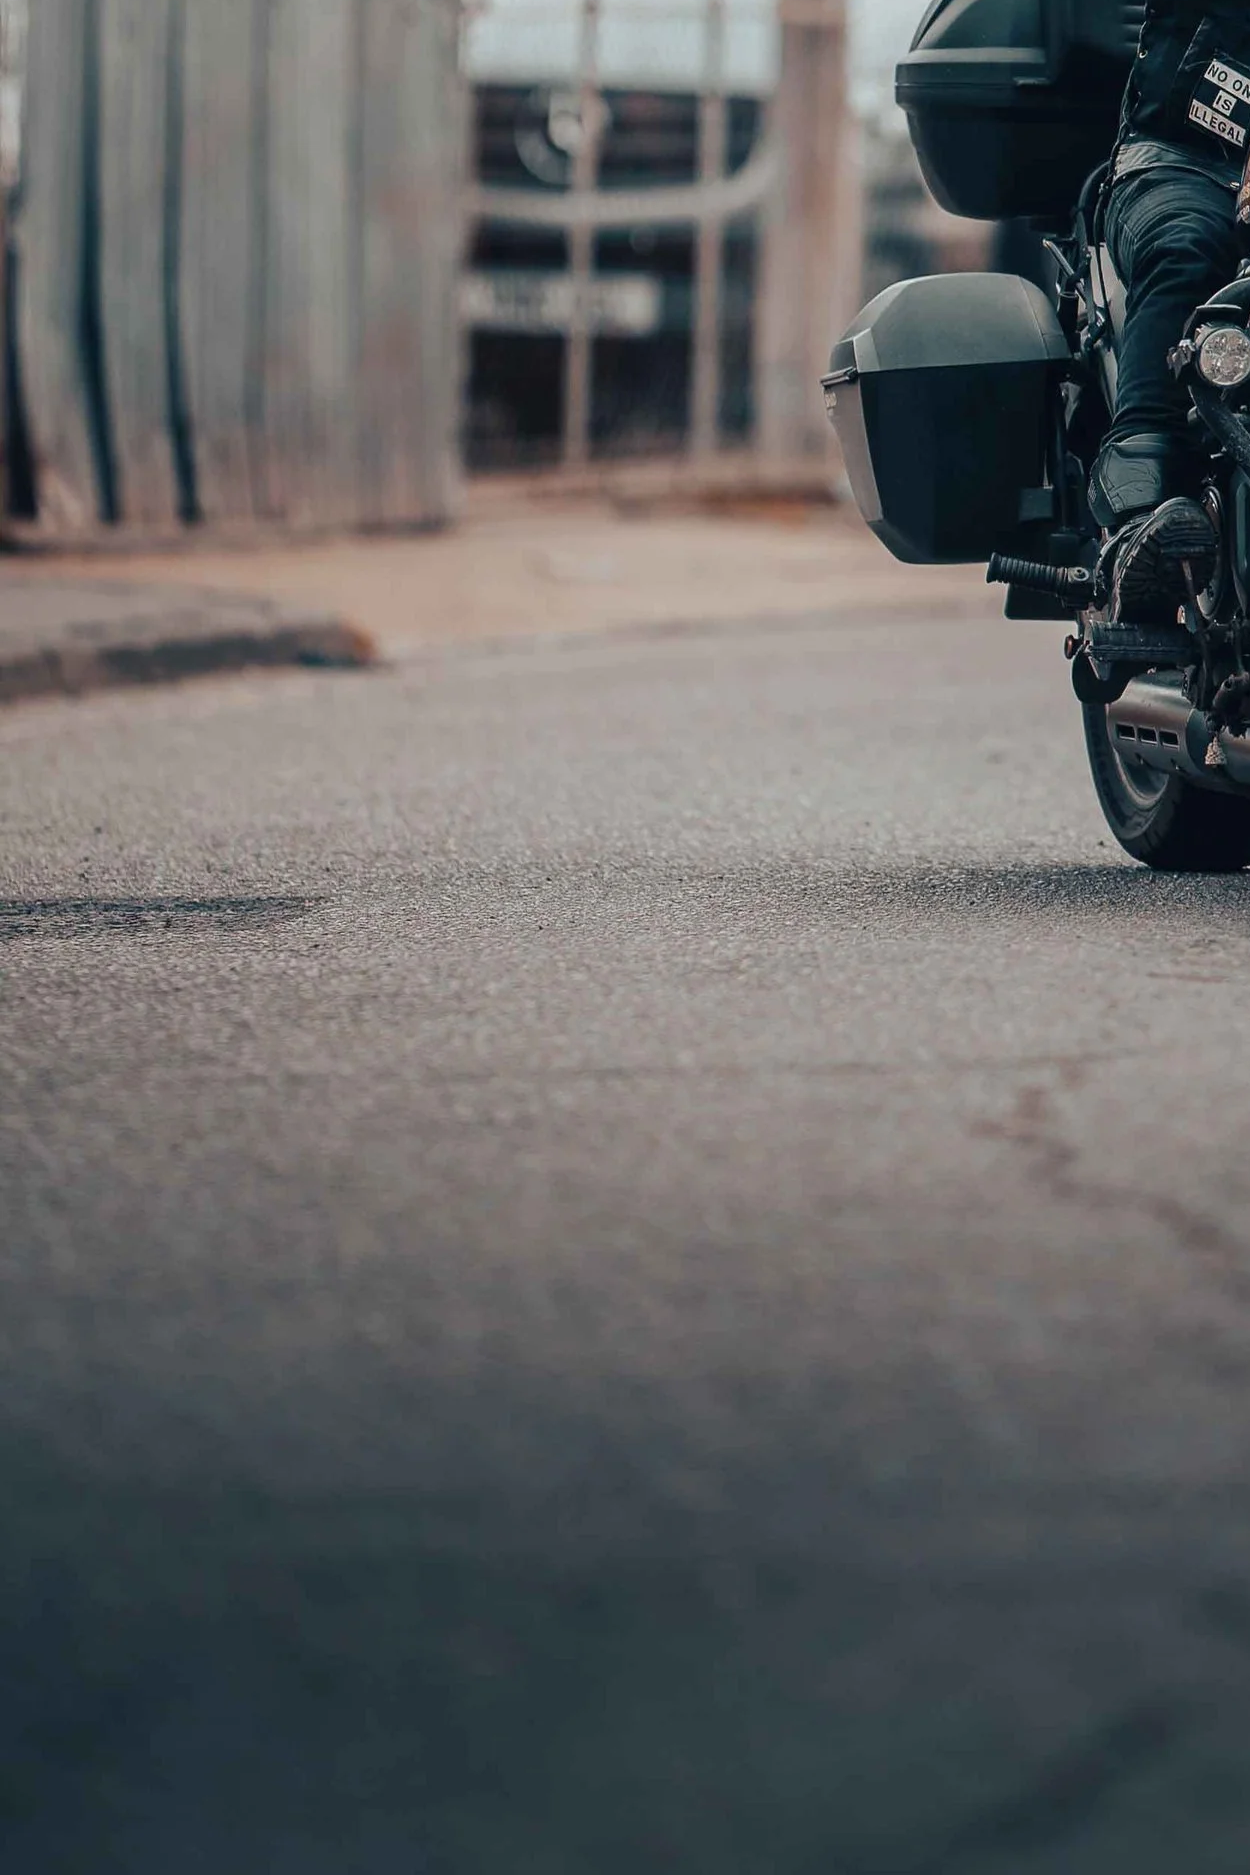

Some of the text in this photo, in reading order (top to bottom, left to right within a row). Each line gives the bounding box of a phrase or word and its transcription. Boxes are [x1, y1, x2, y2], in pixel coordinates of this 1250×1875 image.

[1207, 65, 1228, 83] NO
[1215, 95, 1233, 111] IS
[1190, 104, 1243, 144] ILLEGAL
